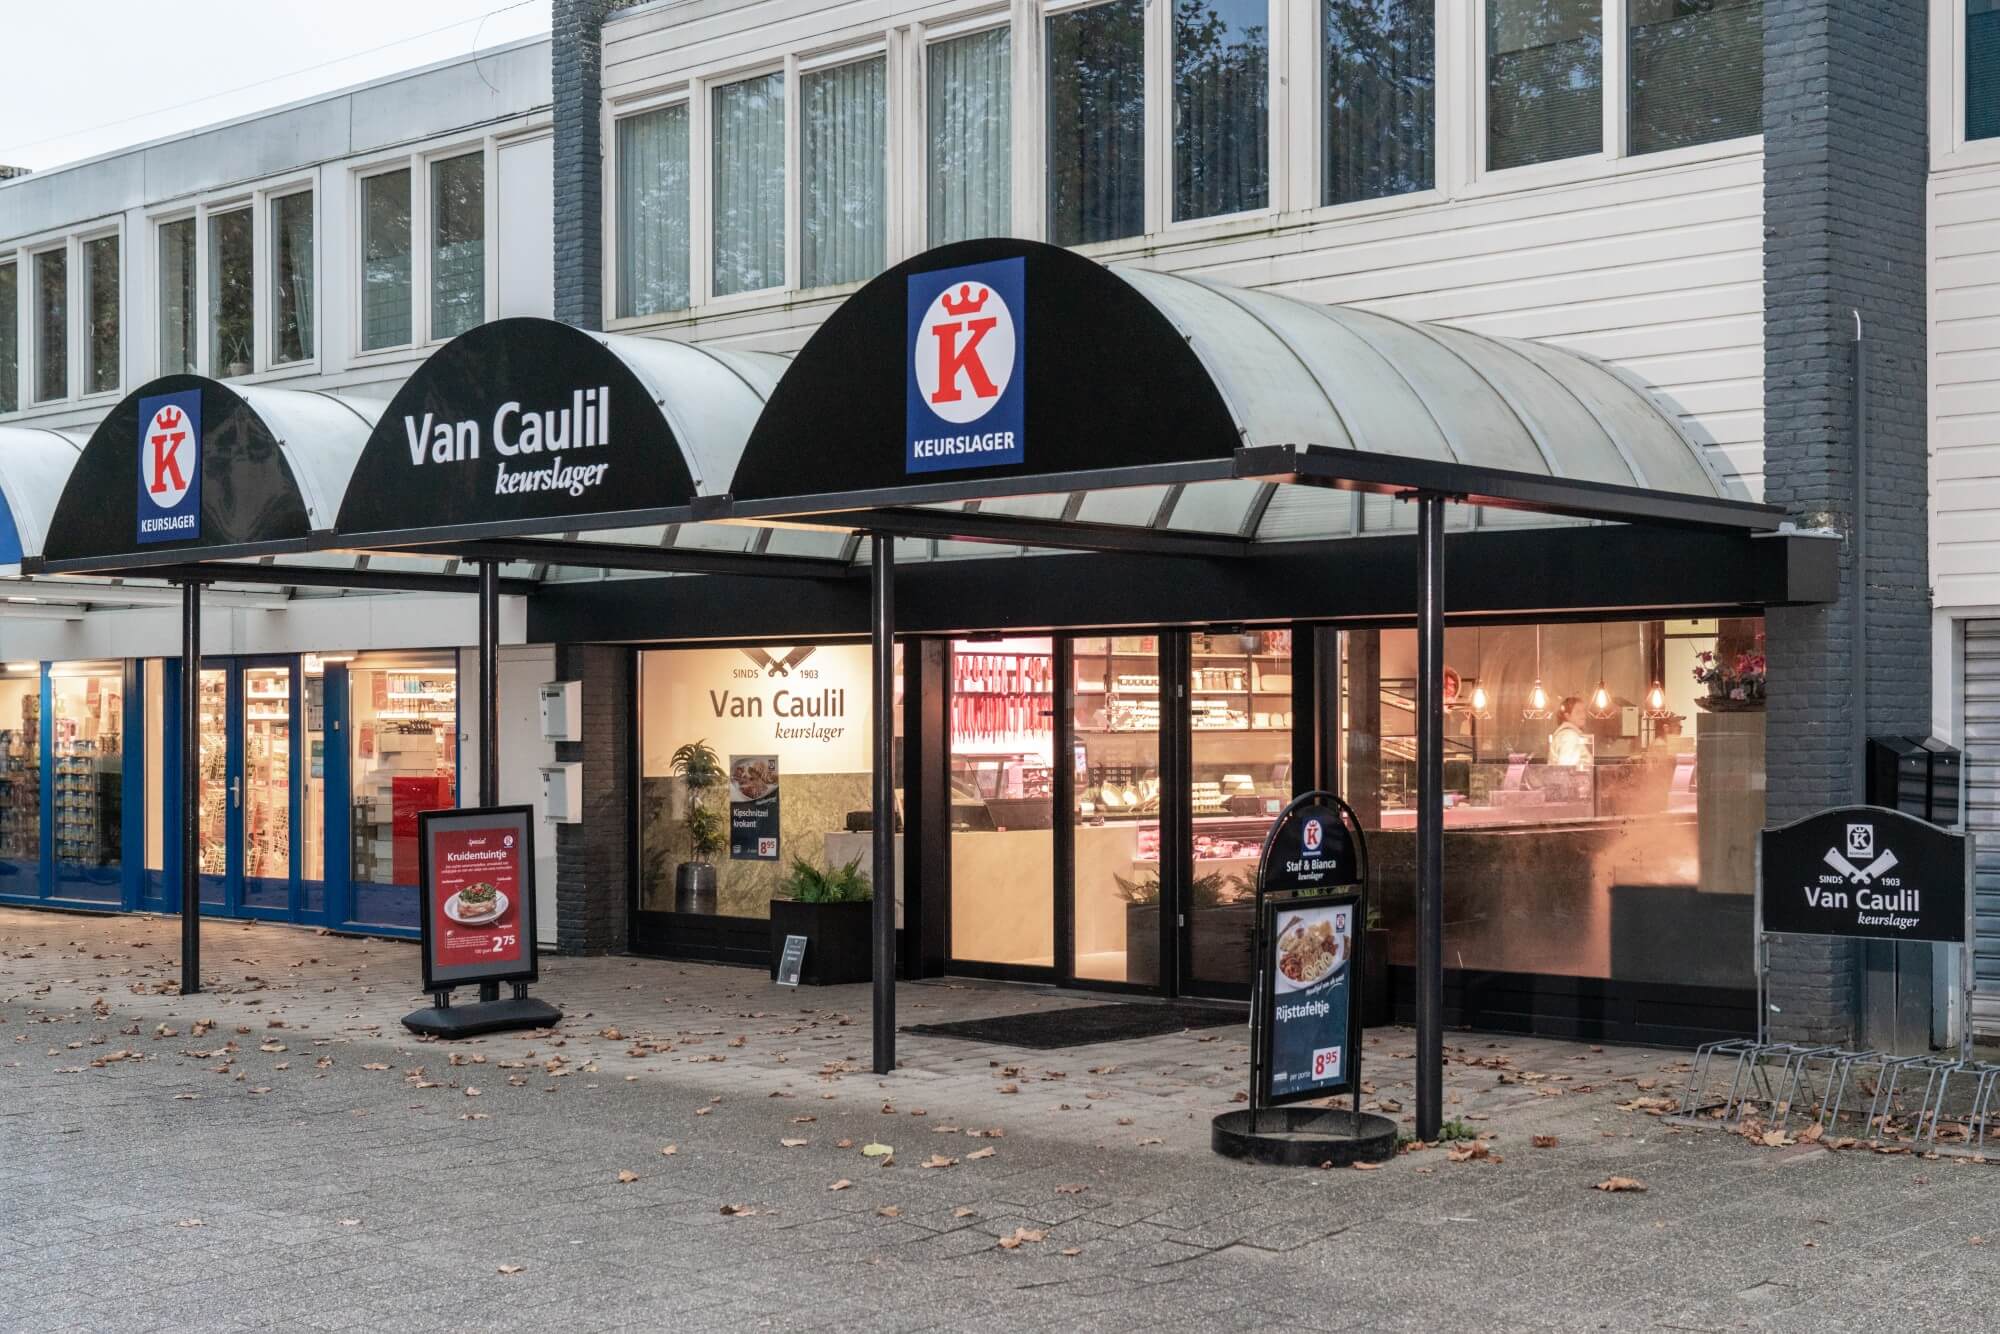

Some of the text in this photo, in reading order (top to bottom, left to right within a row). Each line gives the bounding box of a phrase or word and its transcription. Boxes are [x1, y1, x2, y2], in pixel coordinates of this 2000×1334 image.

[931, 316, 998, 404] K
[404, 386, 609, 466] Van Caulil
[913, 431, 1015, 458] KEURSLAGER
[150, 431, 186, 494] K
[494, 456, 609, 497] keurslager
[141, 514, 195, 533] KEURSLAGER
[733, 669, 819, 679] SINDS 1903
[709, 688, 845, 718] Van Caulil
[775, 722, 845, 742] keurslager
[733, 807, 769, 818] Kipschnitzel
[733, 819, 756, 828] krokant
[1306, 828, 1318, 845] K
[1852, 832, 1868, 848] K
[447, 849, 508, 862] Kruidentuintje
[1286, 858, 1337, 872] Staf & Bianca
[1818, 875, 1901, 887] SINDS 1903
[1804, 886, 1920, 912] Van Caulil
[1857, 911, 1920, 930] keurslager
[1276, 1000, 1330, 1023] Rijsttafeltje
